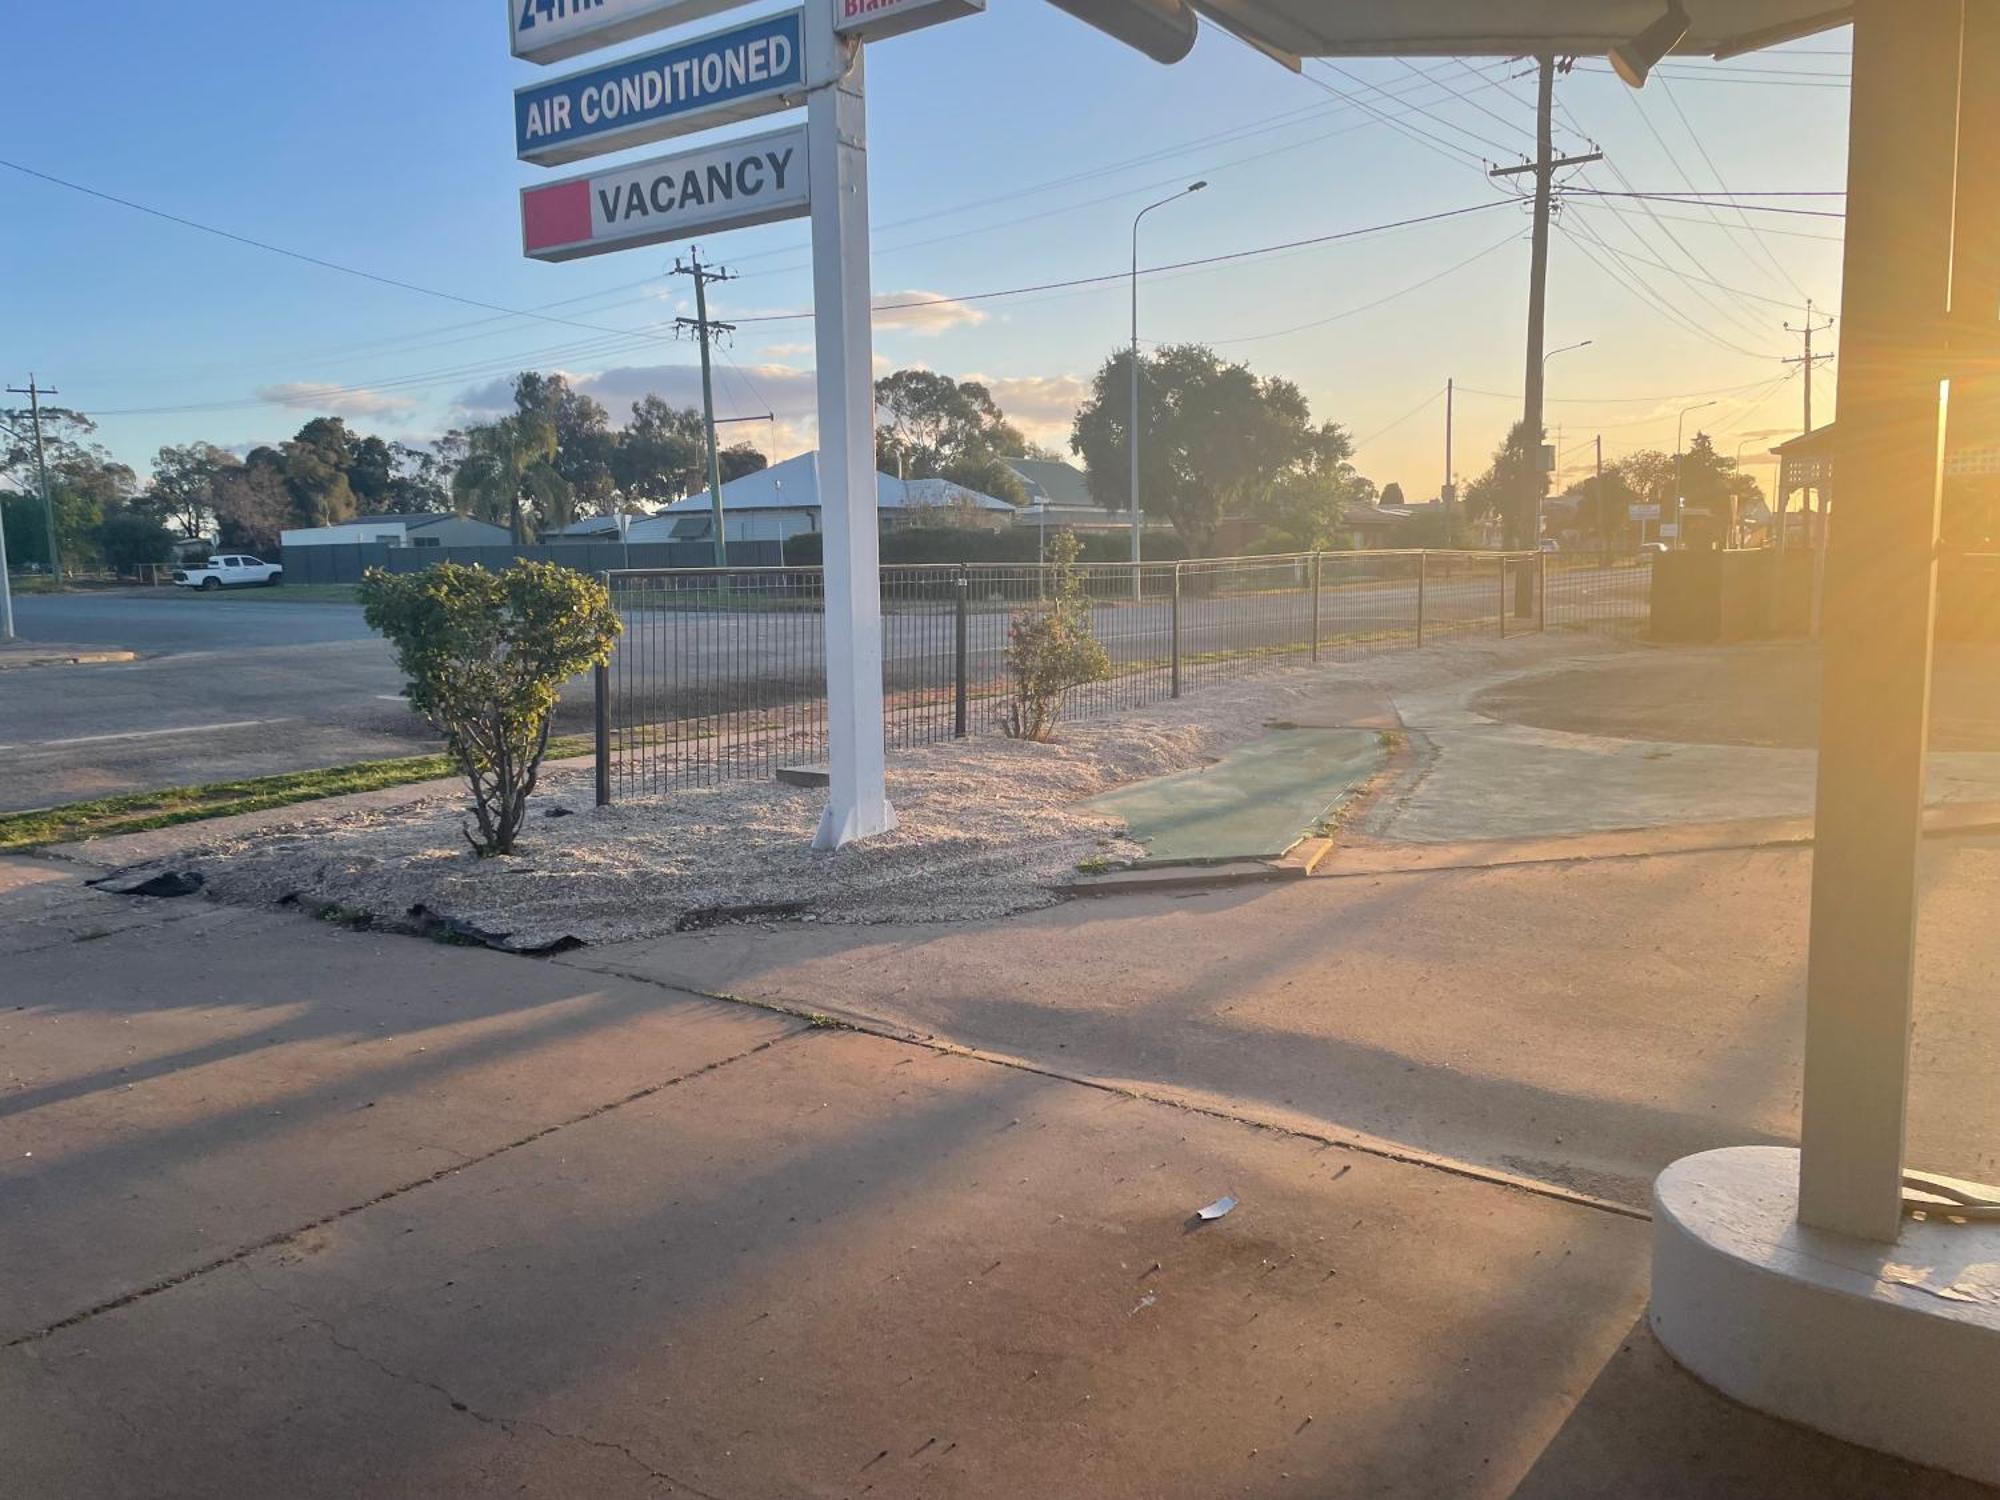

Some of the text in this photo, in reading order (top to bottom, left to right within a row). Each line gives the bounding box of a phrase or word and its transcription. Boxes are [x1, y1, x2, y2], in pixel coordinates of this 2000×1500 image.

[526, 34, 792, 139] AIR CONDITIONED
[598, 148, 793, 223] VACANCY
